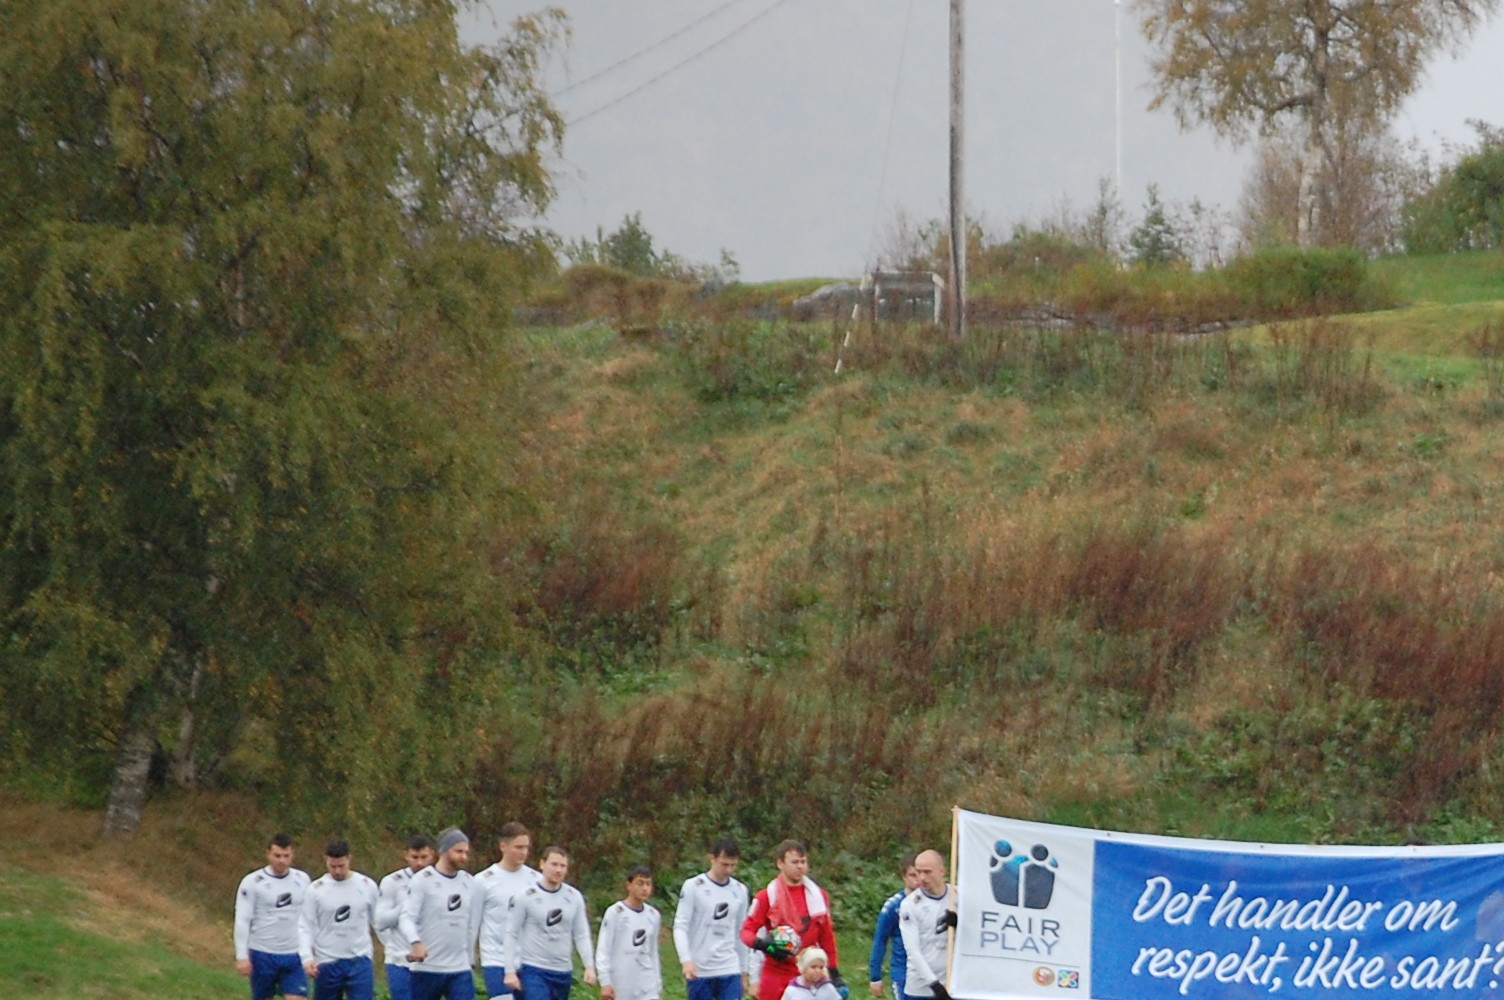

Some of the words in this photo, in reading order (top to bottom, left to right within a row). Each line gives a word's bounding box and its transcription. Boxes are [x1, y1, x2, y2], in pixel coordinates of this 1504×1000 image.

[981, 910, 1060, 938] FAIR
[1132, 876, 1213, 925] Det
[1208, 880, 1383, 931] handler
[1384, 899, 1460, 931] om
[980, 930, 1060, 956] PLAY
[1131, 935, 1290, 995] respekt,
[1293, 937, 1387, 989] ikke
